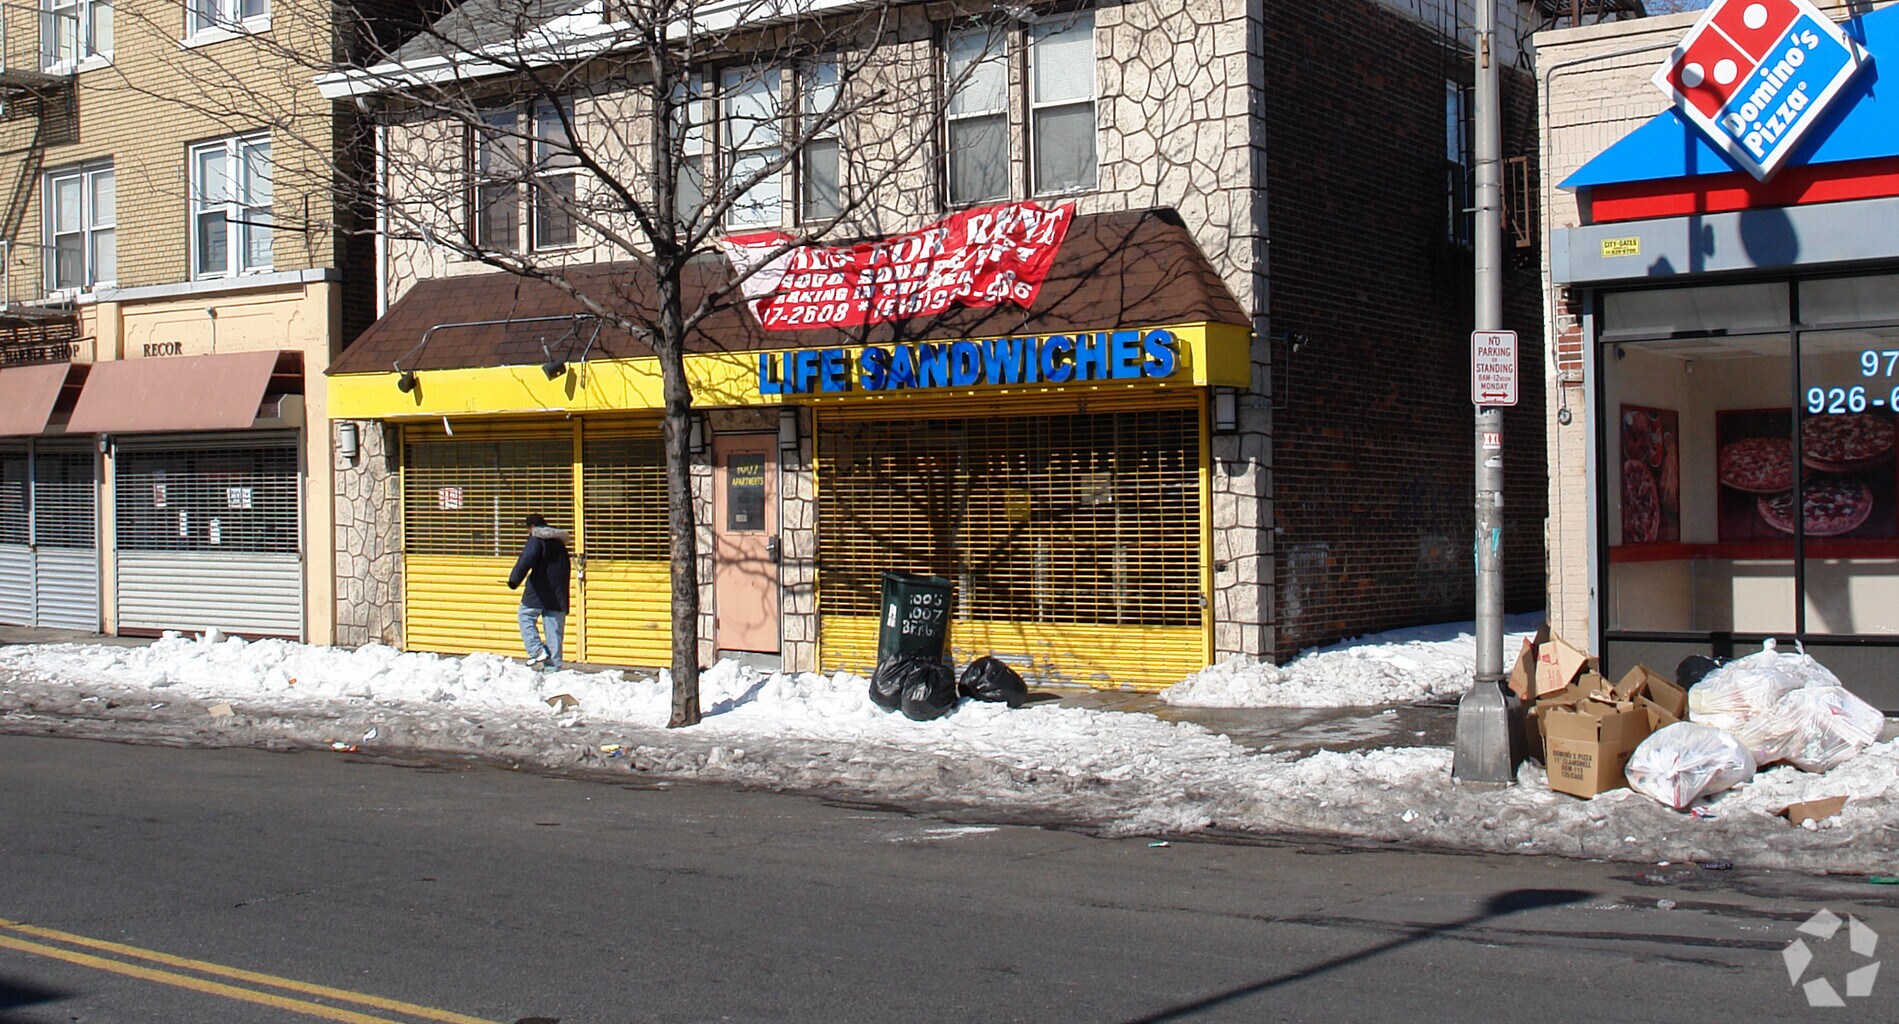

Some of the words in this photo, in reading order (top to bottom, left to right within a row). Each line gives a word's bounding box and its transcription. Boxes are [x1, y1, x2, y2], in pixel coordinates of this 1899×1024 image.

[1720, 28, 1819, 138] Domino's
[773, 287, 849, 305] ARKING
[1488, 336, 1501, 346] NO
[143, 341, 183, 357] RECOR
[1478, 347, 1511, 356] PARKING
[759, 348, 850, 395] LIFE
[860, 328, 1179, 391] SANDWICHES
[1476, 363, 1513, 373] STANDING
[1480, 382, 1508, 390] MONDAY
[1483, 432, 1501, 445] XXL
[732, 477, 764, 486] APARTMENTS
